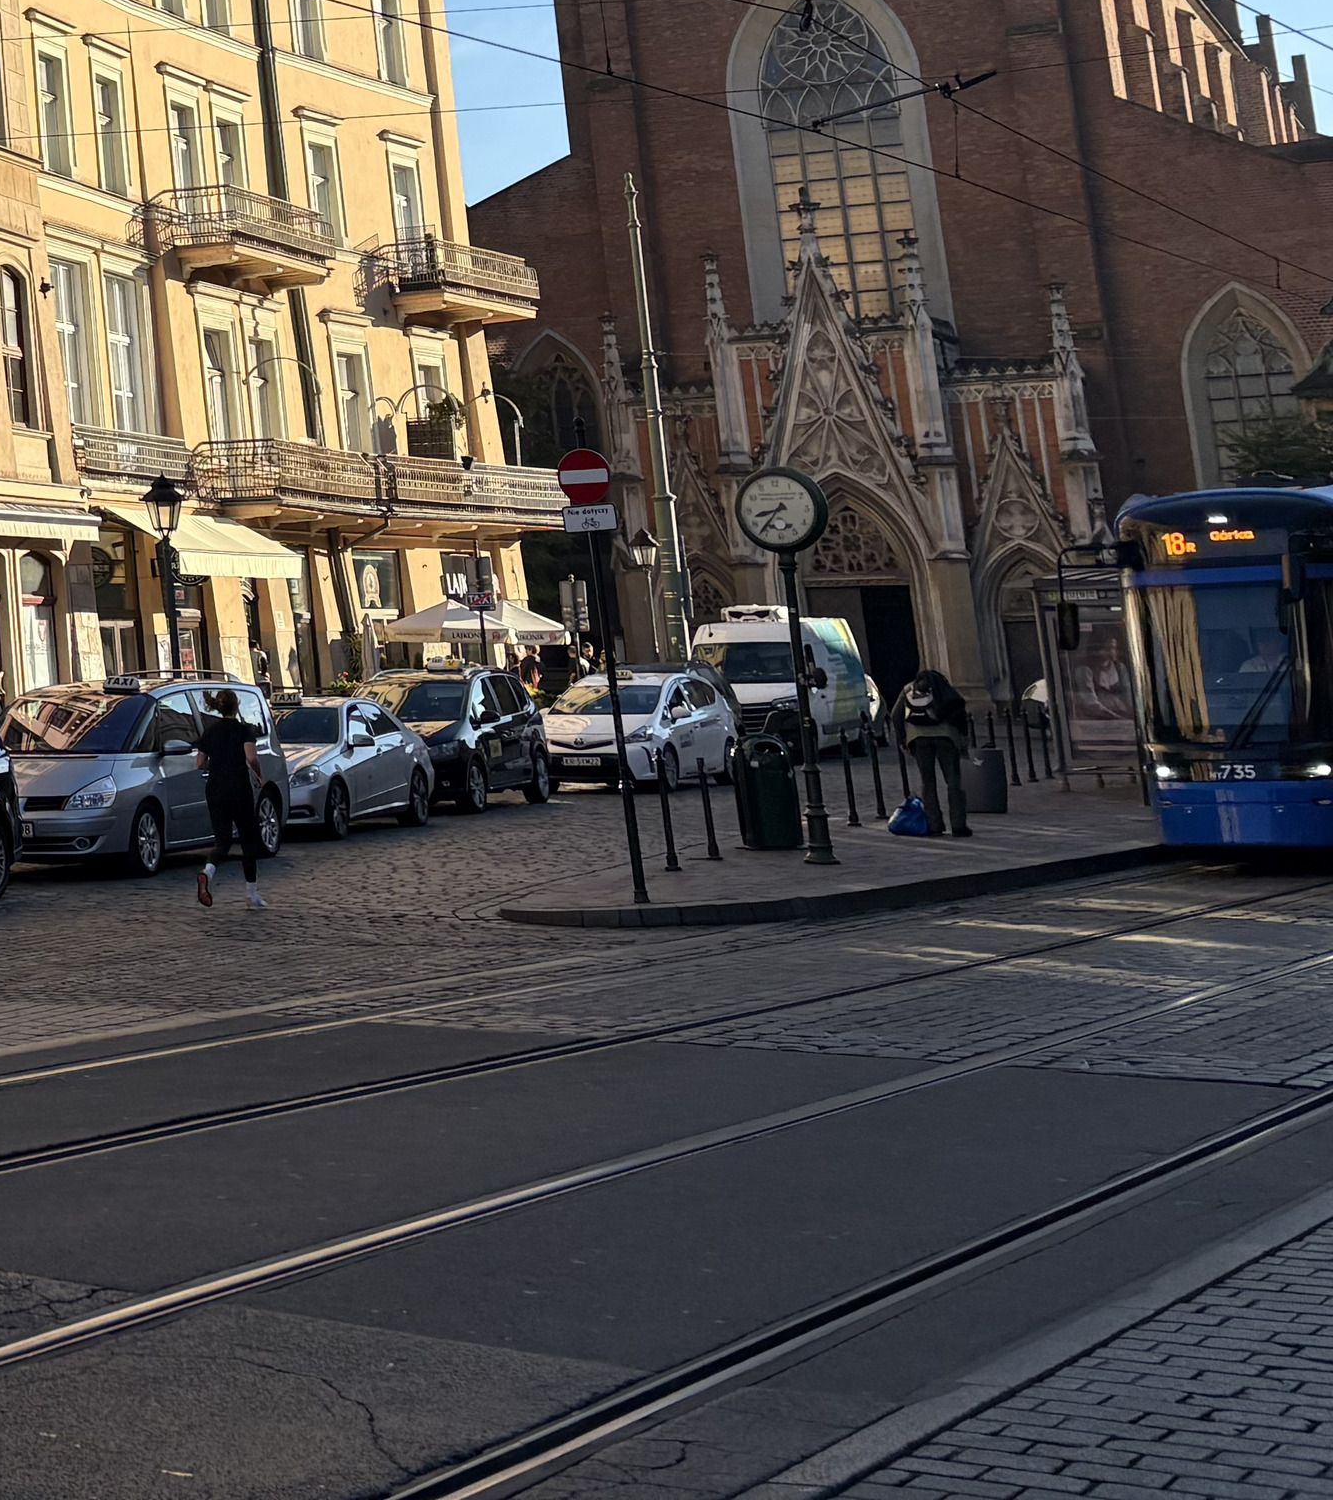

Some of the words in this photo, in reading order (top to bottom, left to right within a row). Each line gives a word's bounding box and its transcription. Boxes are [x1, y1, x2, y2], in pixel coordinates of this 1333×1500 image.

[582, 508, 609, 516] dotyczy
[1209, 529, 1255, 542] Górka
[467, 594, 493, 605] TAXI
[107, 677, 135, 687] TAXI
[274, 694, 297, 702] TAXI
